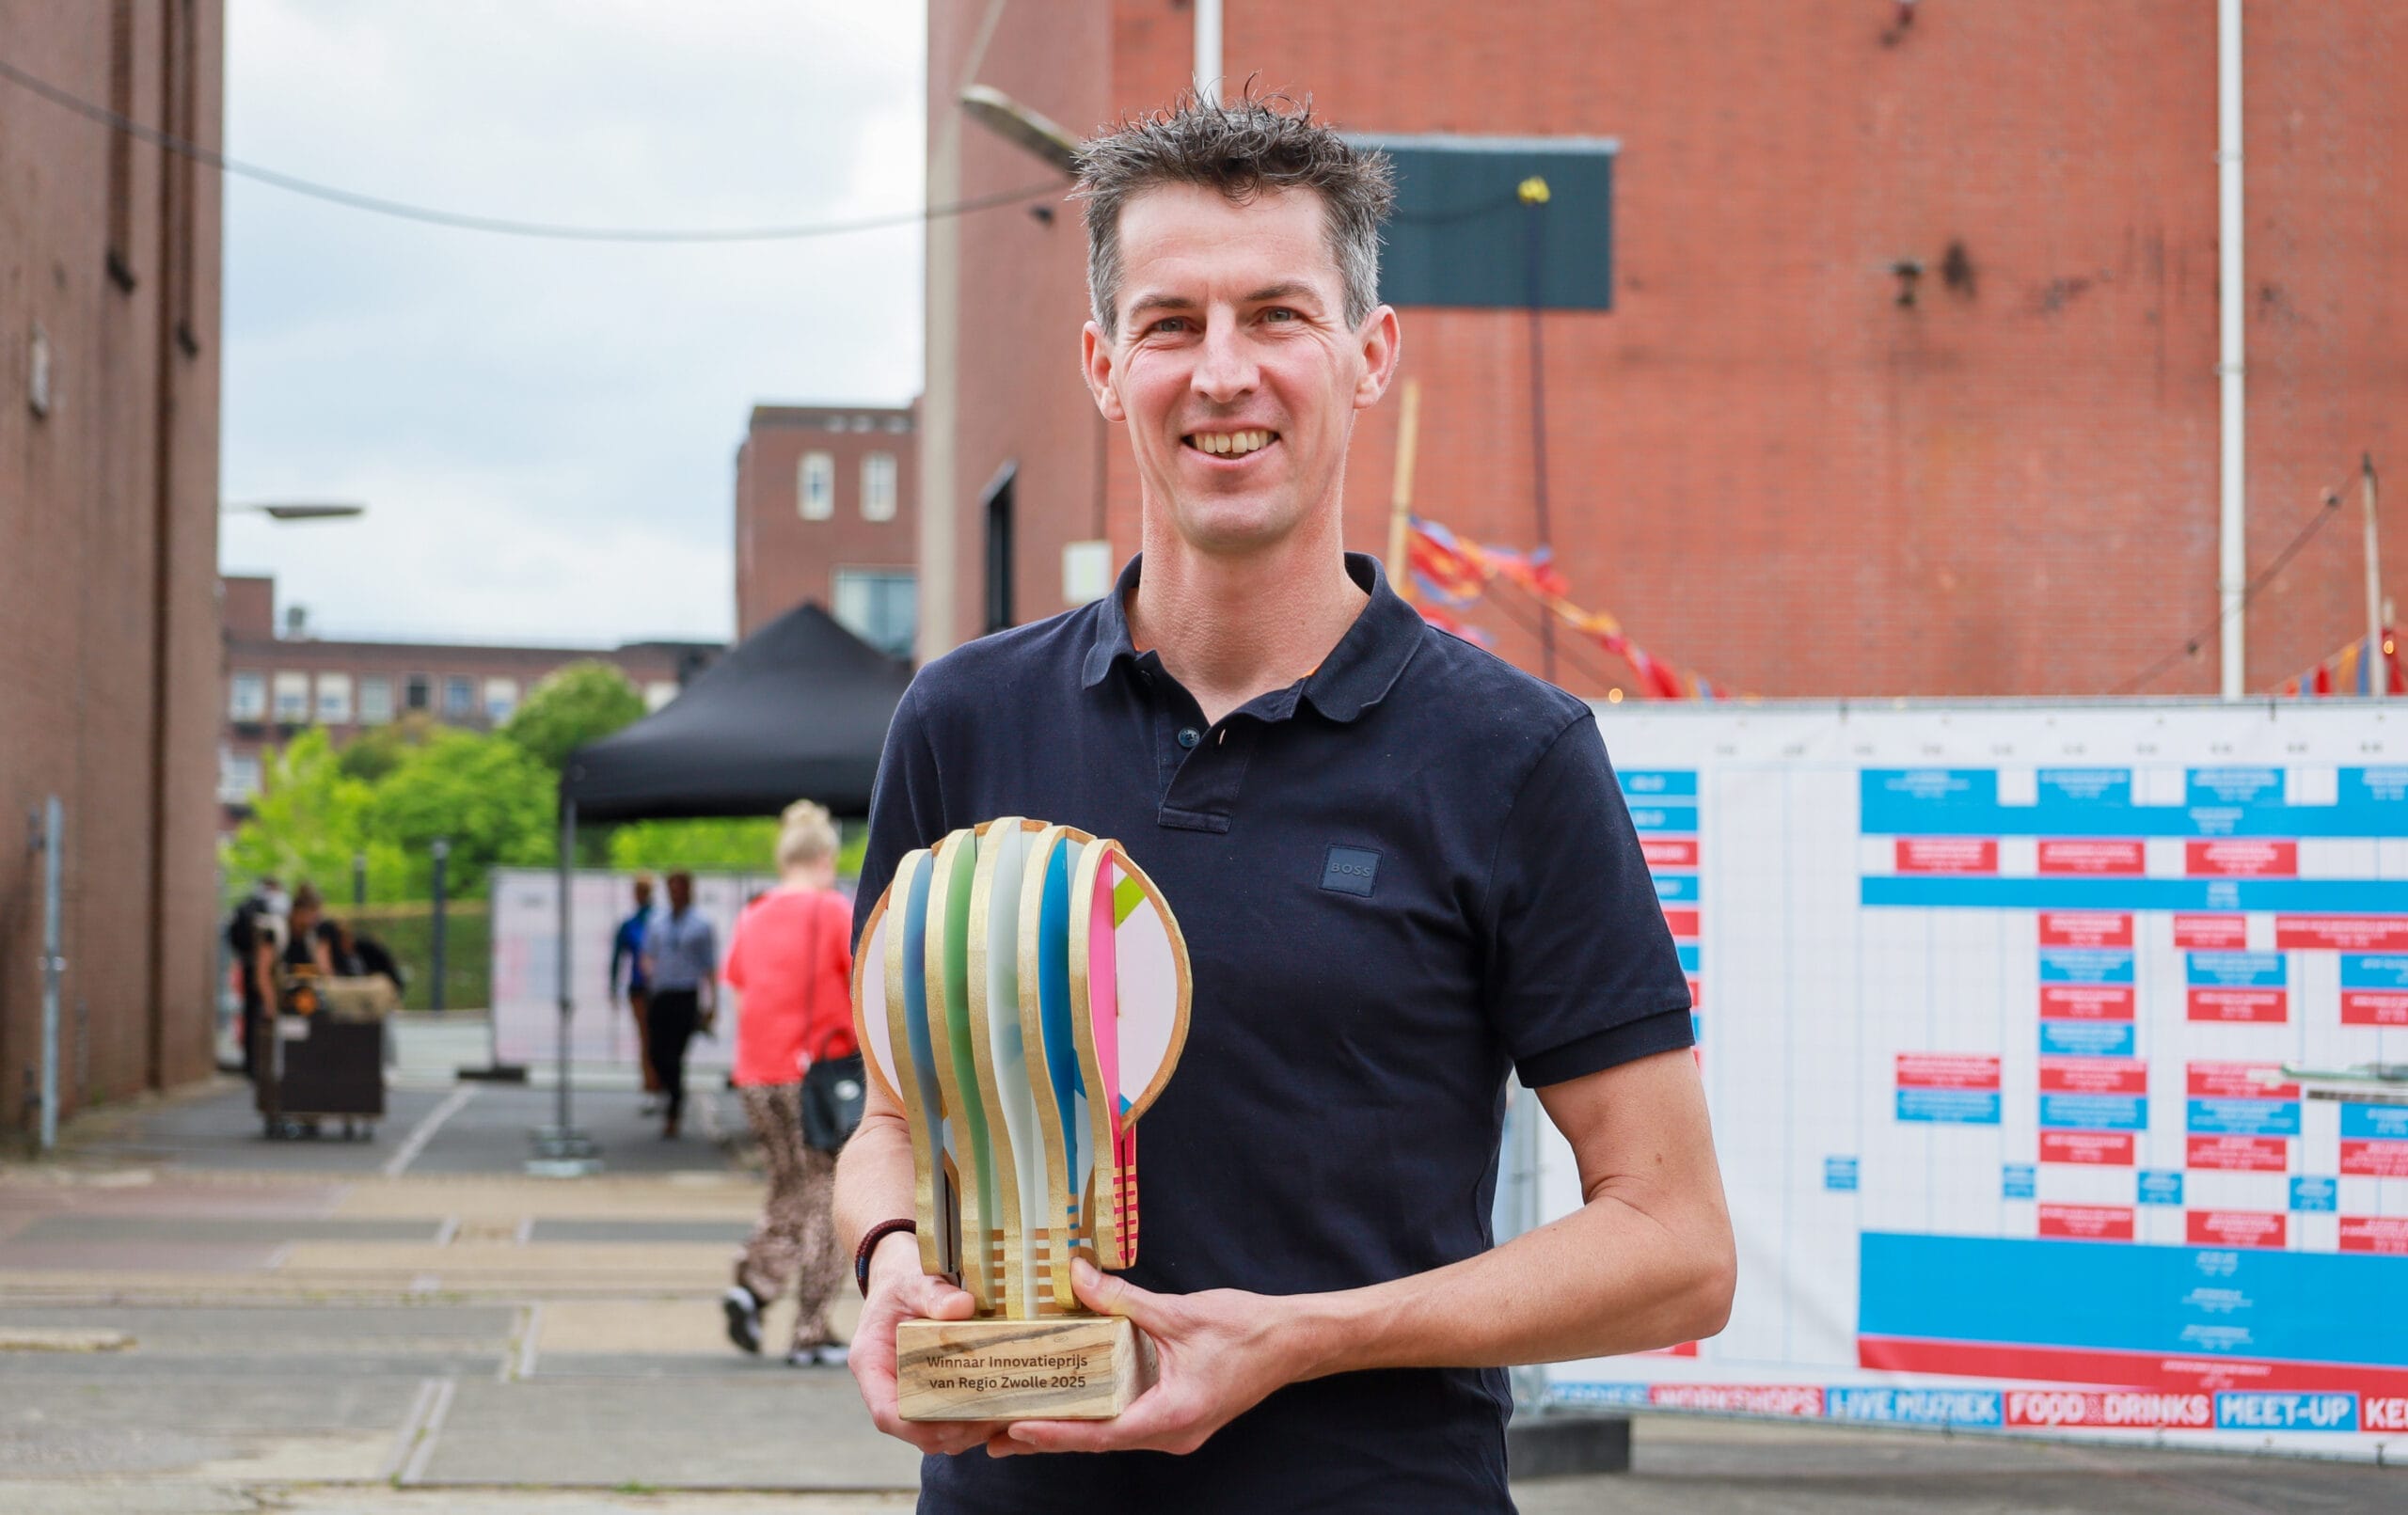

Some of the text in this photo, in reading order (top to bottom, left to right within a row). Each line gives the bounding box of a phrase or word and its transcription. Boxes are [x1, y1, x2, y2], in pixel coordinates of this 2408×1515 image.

[1330, 862, 1370, 877] BOSS
[927, 1354, 1088, 1369] Winnaar Innovatieprijs
[929, 1376, 1086, 1391] van Regio Zwolle 2025
[2220, 1395, 2352, 1427] MEET-UP
[2365, 1397, 2408, 1428] KE
